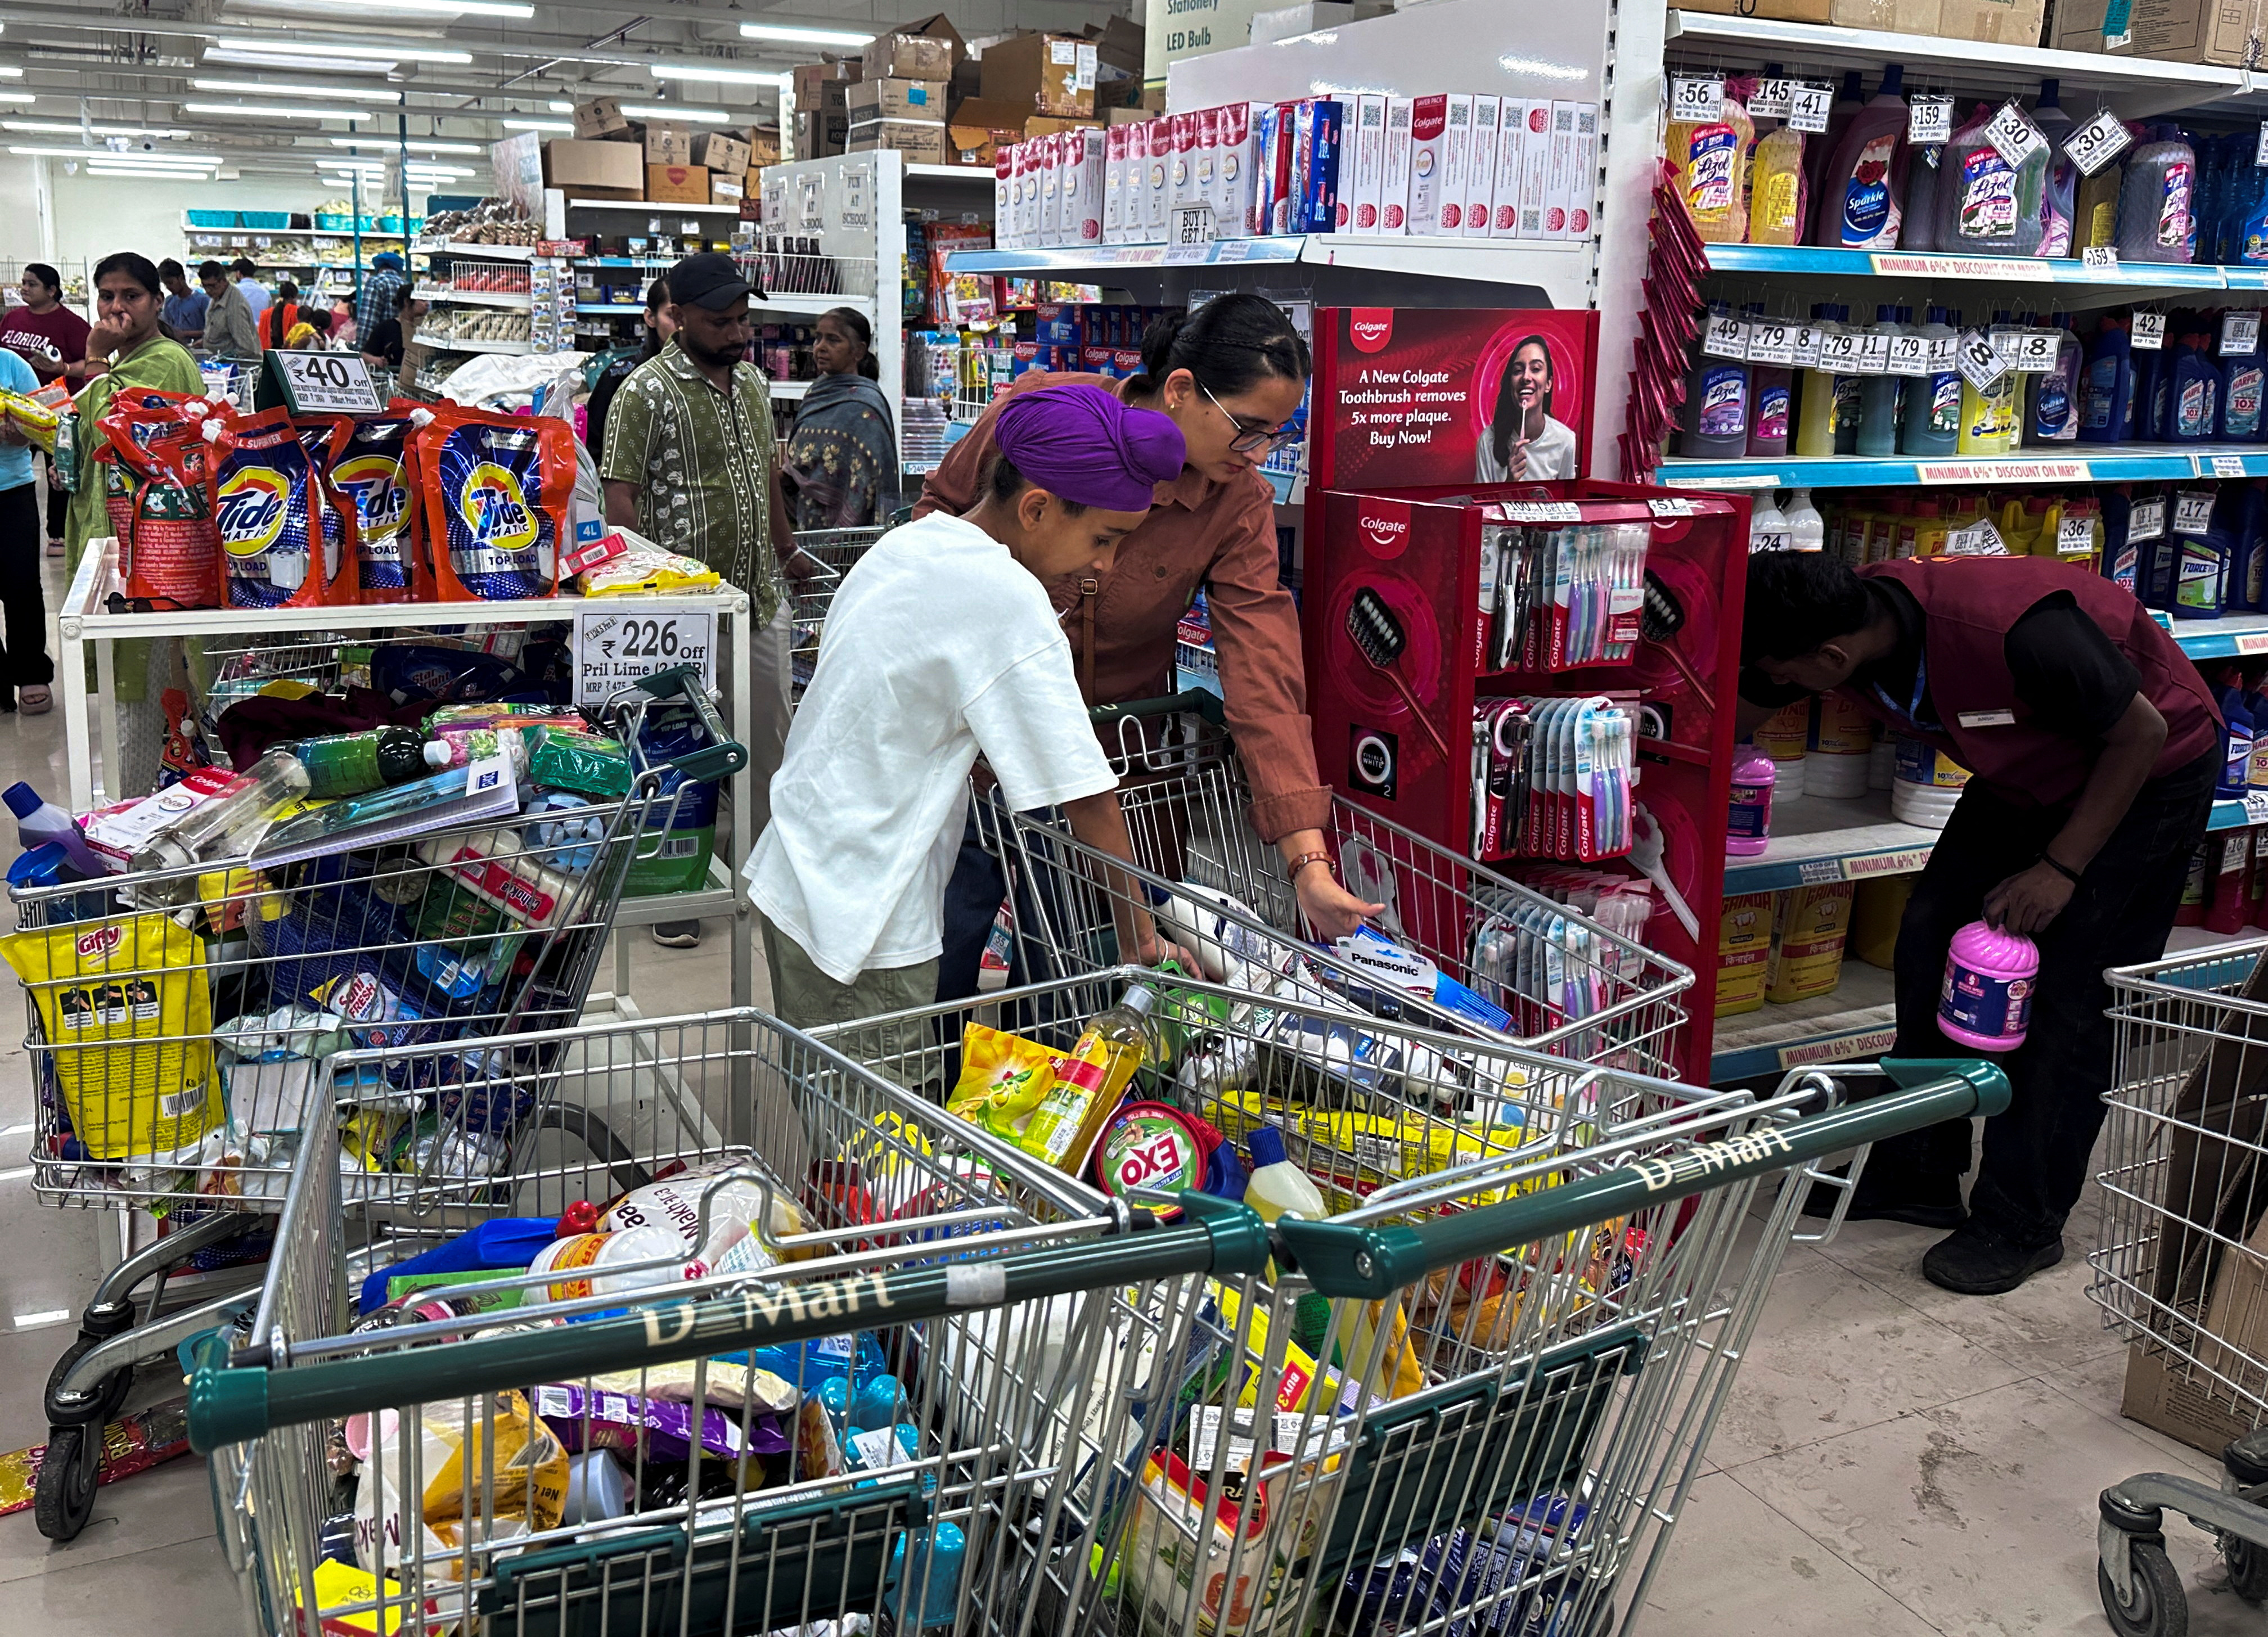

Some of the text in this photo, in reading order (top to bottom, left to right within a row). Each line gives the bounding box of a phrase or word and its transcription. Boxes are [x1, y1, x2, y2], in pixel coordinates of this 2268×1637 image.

[1167, 27, 1211, 51] LED Bulb
[1414, 115, 1443, 129] Colgate
[1415, 156, 1433, 170] Total
[1698, 155, 1730, 179] Lizol
[1973, 177, 2011, 199] Lizol
[850, 194, 860, 206] AT
[1848, 191, 1885, 210] Sparkle
[843, 213, 868, 226] SCHOOL
[1183, 210, 1208, 227] BUY 1
[1181, 228, 1206, 243] GET 1
[1880, 258, 1928, 273] MINIMUM
[1954, 260, 2002, 276] DISCOUNT
[1037, 305, 1060, 316] Colgate
[1354, 322, 1388, 333] Colgate
[1015, 344, 1037, 356] Colgate
[1085, 347, 1109, 360] Colgate
[1115, 351, 1141, 364] Colgate
[1359, 369, 1450, 387] A New Colgate
[2233, 373, 2258, 391] HARPIC
[1339, 390, 1466, 405] Toothbrush removes
[1711, 384, 1740, 404] Lizol
[1939, 385, 1959, 401] Lizol
[2183, 384, 2203, 401] HARPIC
[1767, 400, 1787, 417] Lizol
[2040, 397, 2066, 412] Sparkle
[2234, 399, 2255, 409] 10X
[1351, 409, 1452, 426] 5x more plaque.
[2186, 408, 2199, 417] 10X
[1370, 431, 1432, 449] Buy Now!
[1926, 466, 1971, 480] MINIMUM
[1996, 465, 2041, 479] DISCOUNT
[2042, 465, 2057, 478] ON
[336, 476, 404, 518] Tide
[218, 490, 284, 533] Tide
[471, 487, 525, 537] Tide
[491, 522, 529, 538] MATIC
[583, 525, 597, 536] 4L
[1360, 516, 1406, 534] Colgate
[223, 526, 271, 542] MATIC
[368, 544, 399, 556] LOAD
[241, 561, 267, 572] LOAD
[488, 553, 537, 567] TOP LOAD
[1525, 620, 1536, 668] Colgate
[1551, 617, 1562, 668] Colgate
[680, 646, 705, 659] Off
[583, 663, 650, 677] Pril Lime
[586, 682, 602, 693] MRP
[672, 721, 688, 730] LOAD
[210, 766, 231, 777] SAVER
[1362, 758, 1385, 770] WHITE
[1383, 785, 1392, 797] 2
[158, 796, 188, 808] Total
[1486, 804, 1497, 852] Colgate
[1531, 804, 1541, 852] Colgate
[1545, 805, 1554, 853] Colgate
[1559, 806, 1569, 856] Colgate
[1850, 854, 1896, 874] MINIMUM
[1351, 952, 1420, 977] Panasonic
[348, 982, 376, 1019] FRESH
[1786, 1045, 1833, 1066] MINIMUM
[1277, 1369, 1302, 1408] BUY 3
[541, 1486, 559, 1501] Net
